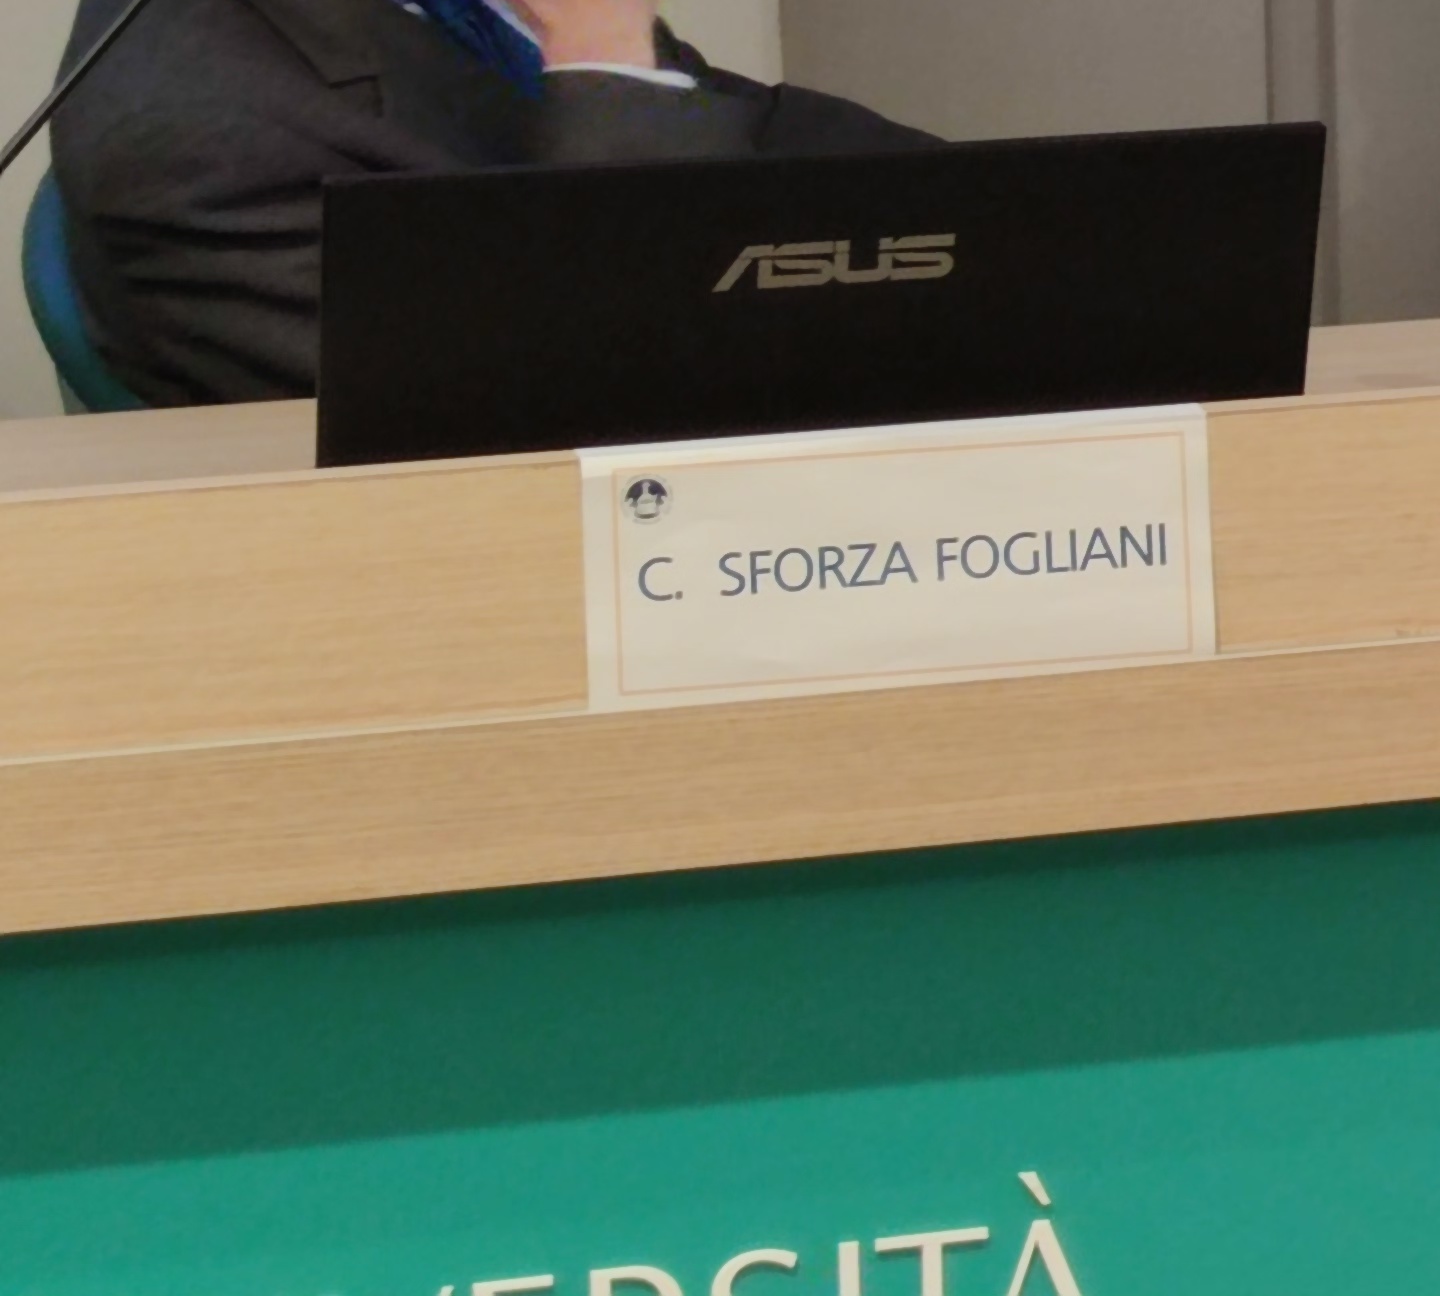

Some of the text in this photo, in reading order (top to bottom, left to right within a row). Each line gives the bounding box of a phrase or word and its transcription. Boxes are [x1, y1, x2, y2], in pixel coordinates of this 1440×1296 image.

[712, 233, 956, 293] ASUS
[637, 522, 1168, 602] C. SFORZA FOGLIANI
